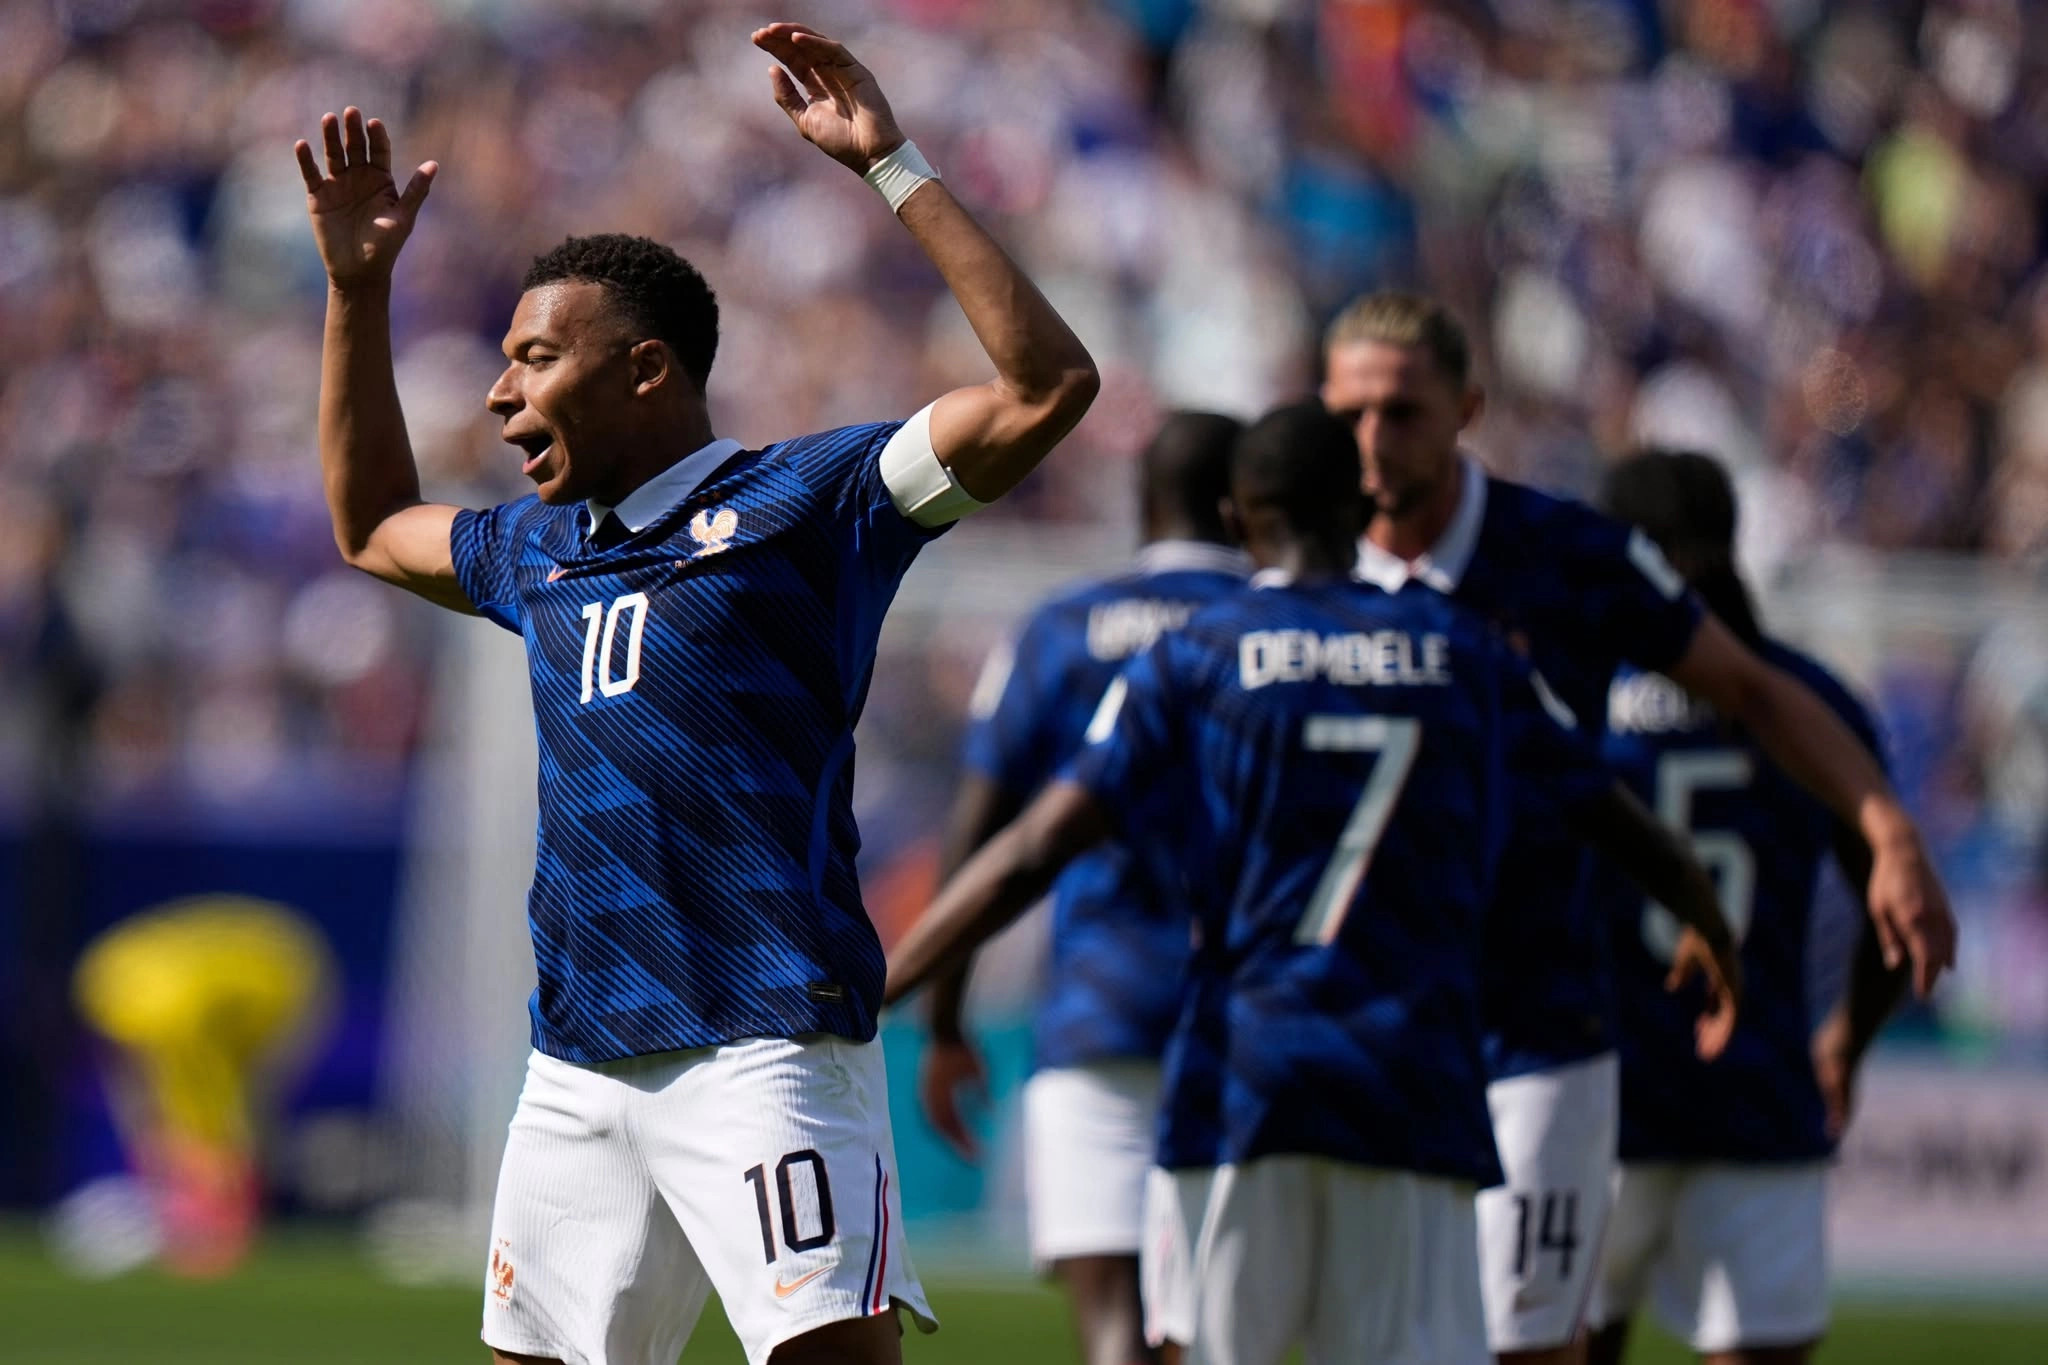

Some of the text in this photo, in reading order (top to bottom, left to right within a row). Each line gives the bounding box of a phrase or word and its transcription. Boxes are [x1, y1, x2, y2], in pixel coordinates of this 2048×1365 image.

[580, 592, 649, 703] 10
[1238, 629, 1452, 690] DEMBELE
[1296, 715, 1421, 946] 7
[1641, 750, 1755, 964] 5
[744, 1148, 836, 1264] 10
[1513, 1192, 1580, 1279] 14
